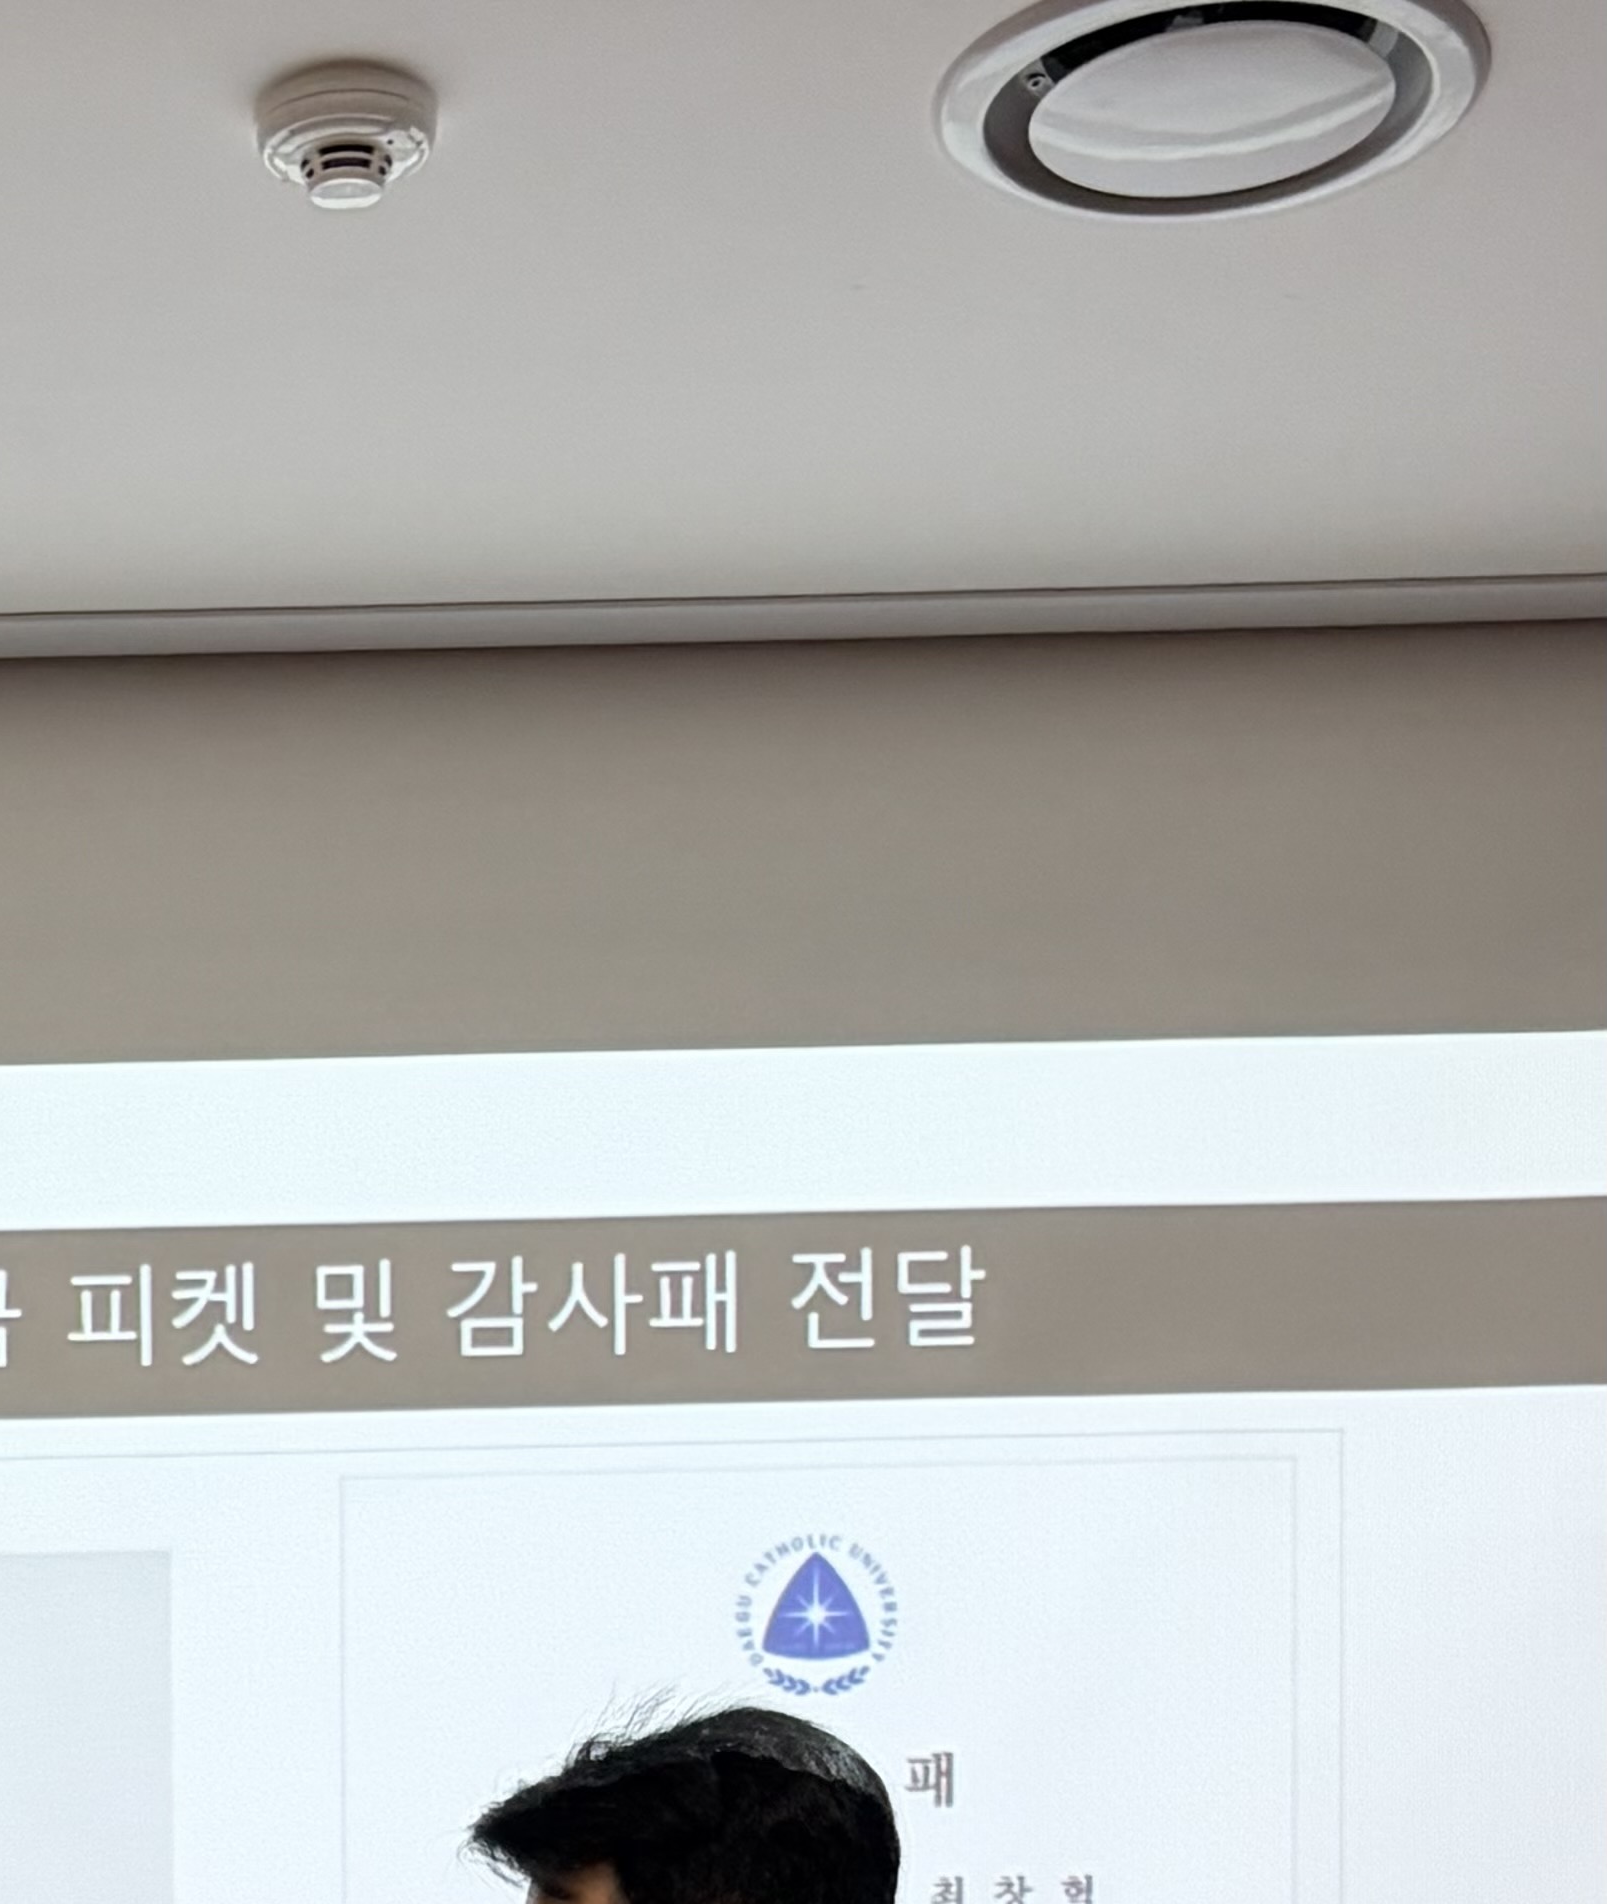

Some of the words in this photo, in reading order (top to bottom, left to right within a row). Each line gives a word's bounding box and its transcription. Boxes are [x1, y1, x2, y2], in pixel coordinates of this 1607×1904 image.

[65, 1263, 261, 1369] 피켓
[314, 1260, 400, 1366] 및
[445, 1250, 741, 1358] 감사패
[789, 1244, 988, 1350] 전달
[745, 1533, 842, 1587] CATHOLIC
[735, 1595, 764, 1666] DAEGU
[848, 1542, 898, 1662] UNIVERSITY
[905, 1752, 954, 1808] 패
